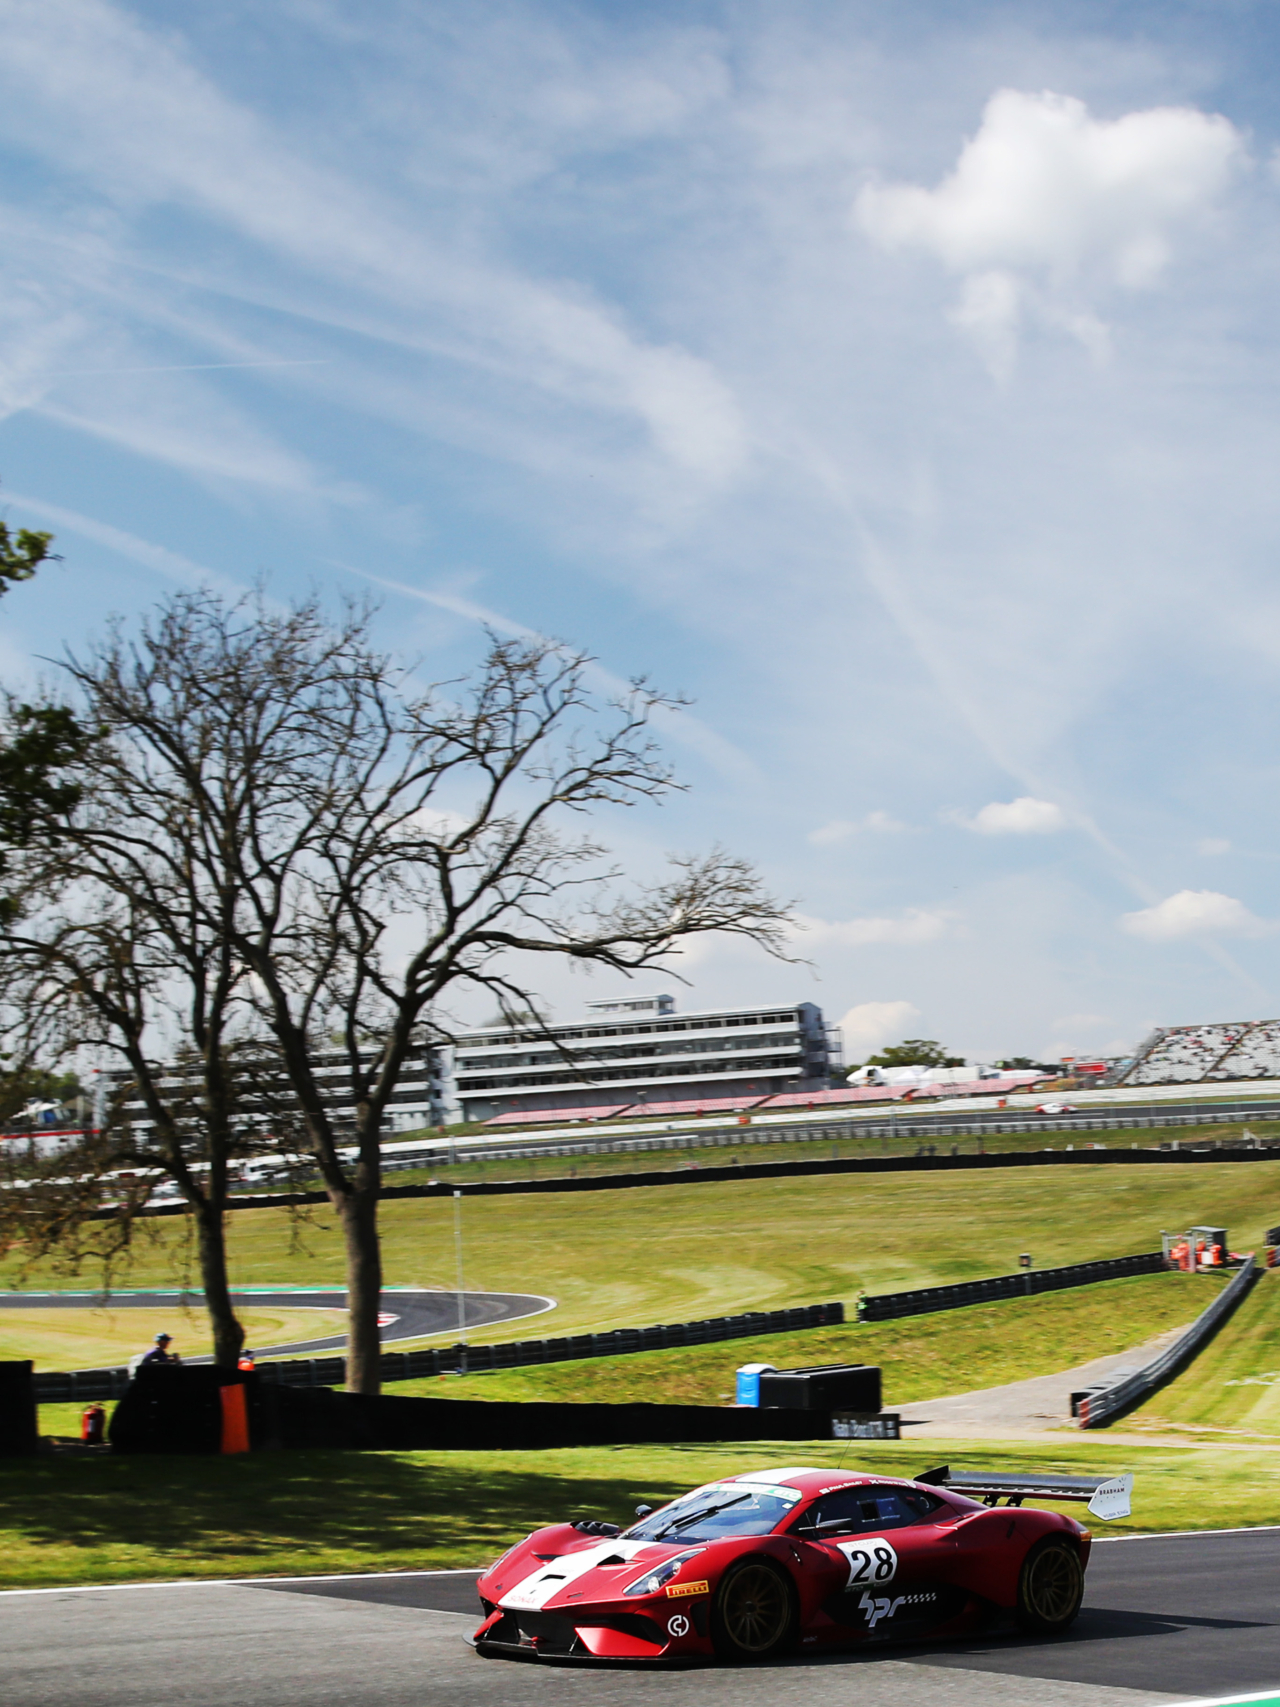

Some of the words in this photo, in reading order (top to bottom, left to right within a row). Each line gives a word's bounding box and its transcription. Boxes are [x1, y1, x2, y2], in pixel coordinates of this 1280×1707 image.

[1099, 1487, 1125, 1495] BRABHAM
[851, 1547, 894, 1584] 28
[667, 1581, 708, 1597] PIRELLI
